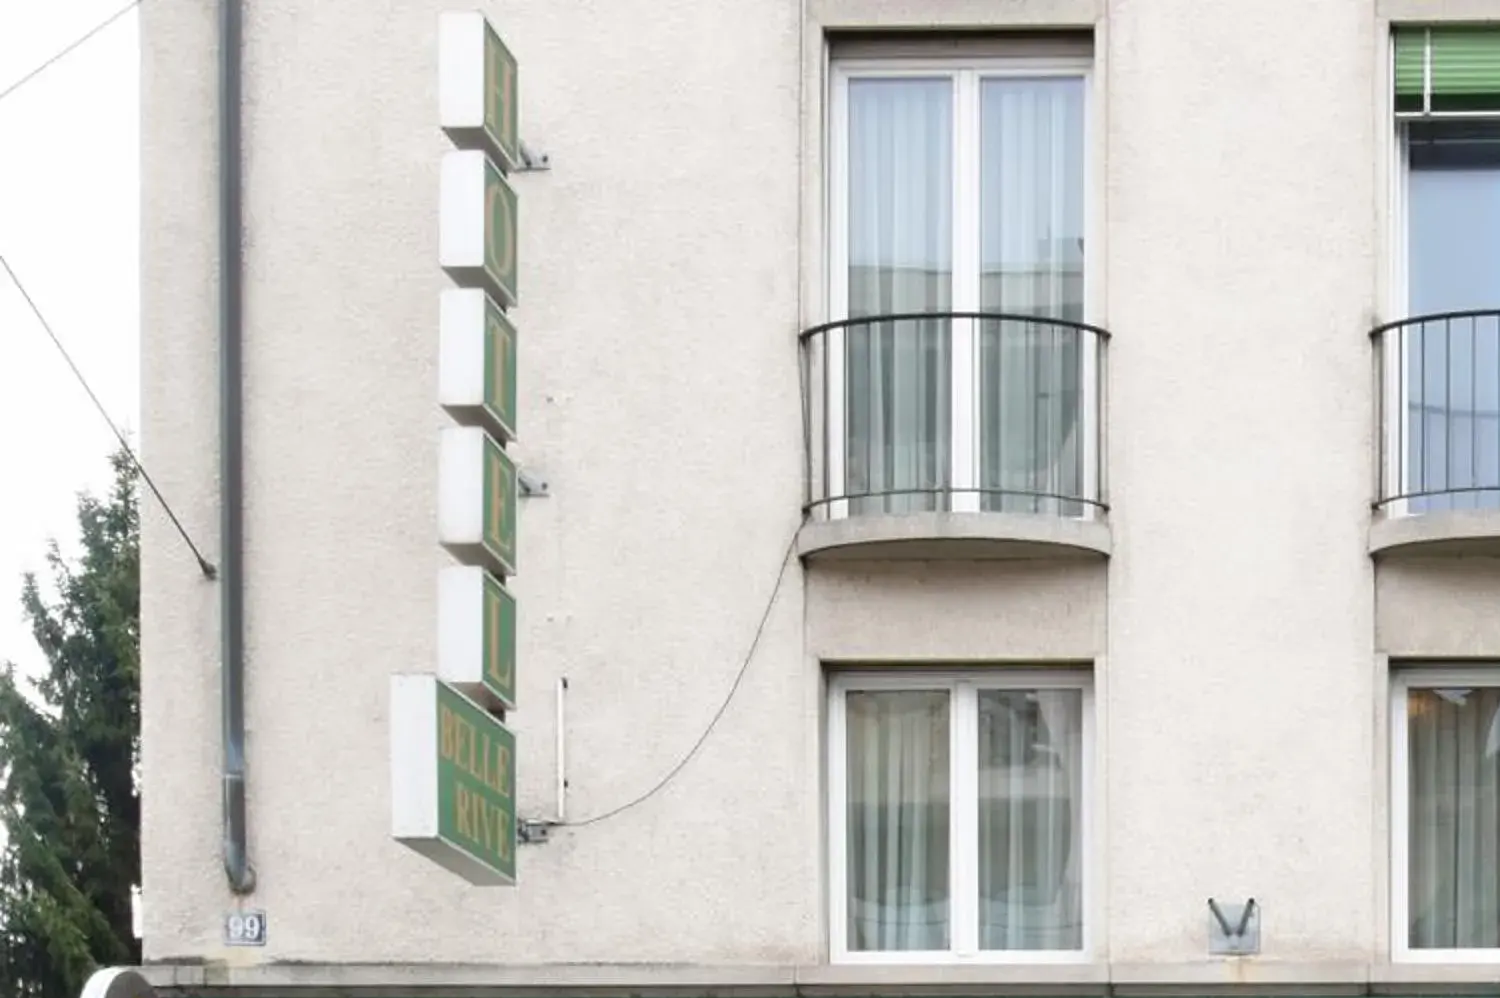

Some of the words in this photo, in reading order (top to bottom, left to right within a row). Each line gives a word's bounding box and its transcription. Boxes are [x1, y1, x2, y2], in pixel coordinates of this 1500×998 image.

[485, 27, 515, 688] HOTEL
[441, 703, 511, 798] BELLE
[456, 781, 511, 863] RIVE
[228, 915, 260, 940] 99
